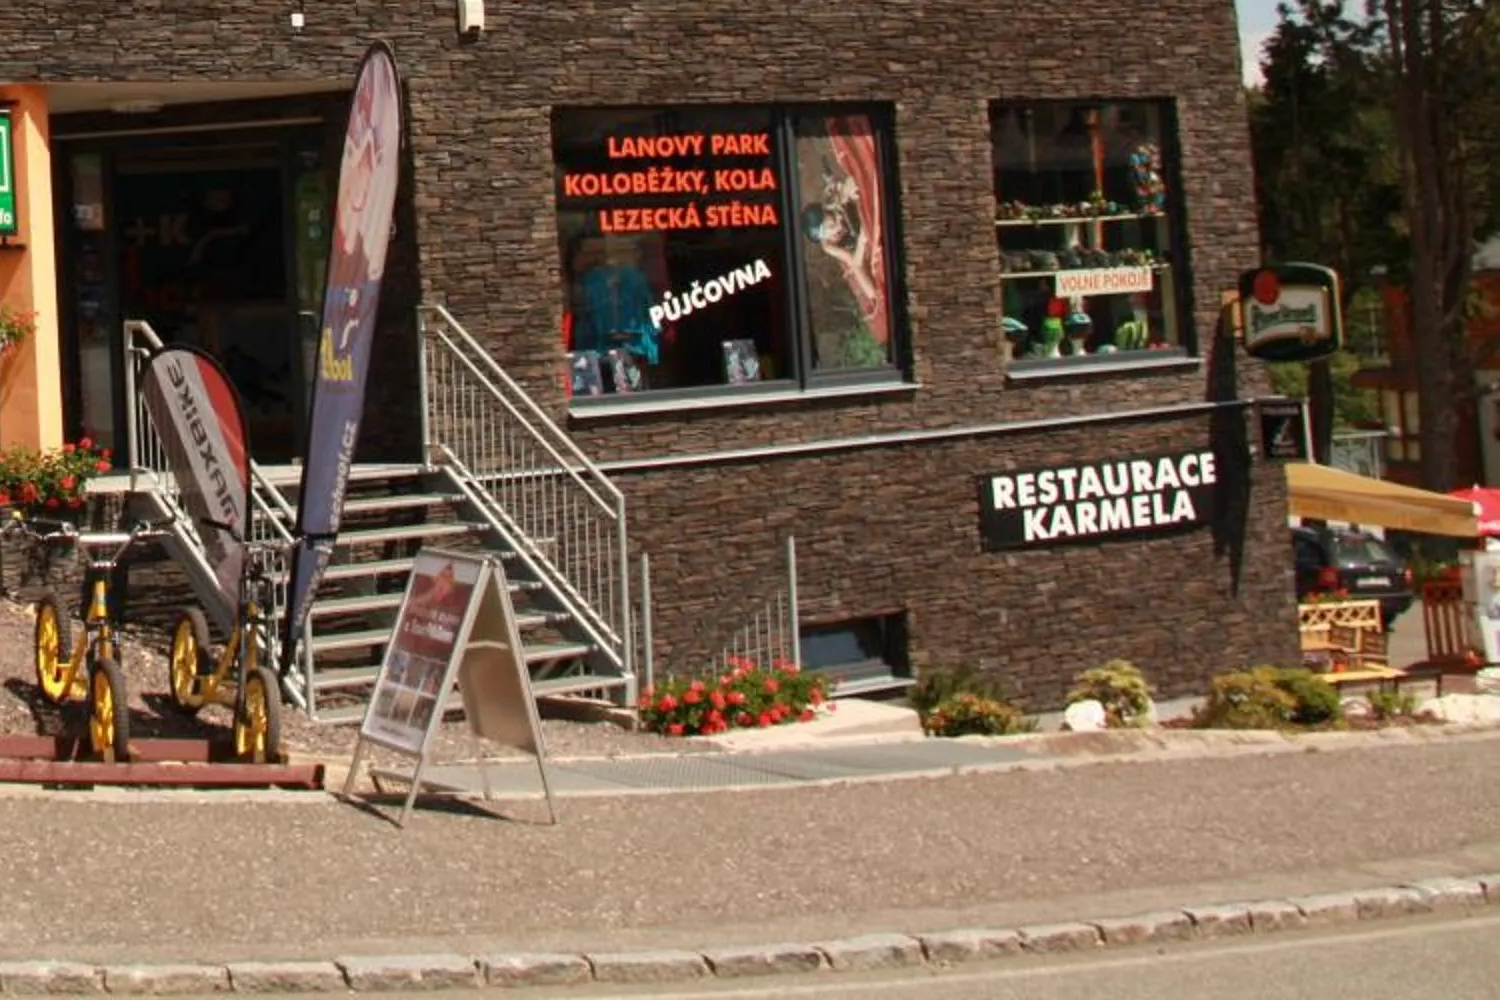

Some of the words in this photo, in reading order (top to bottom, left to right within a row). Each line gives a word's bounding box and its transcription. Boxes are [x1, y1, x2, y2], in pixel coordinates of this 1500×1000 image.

[710, 133, 770, 155] PARK
[564, 166, 710, 196] KOLOBĚŽKY,
[714, 167, 776, 191] KOLA
[600, 202, 701, 232] LEZECKÁ
[705, 201, 778, 228] STĚNA
[648, 258, 772, 329] PŮJČOVNA
[991, 452, 1218, 510] RESTAURACE
[1023, 489, 1196, 542] KARMELA
